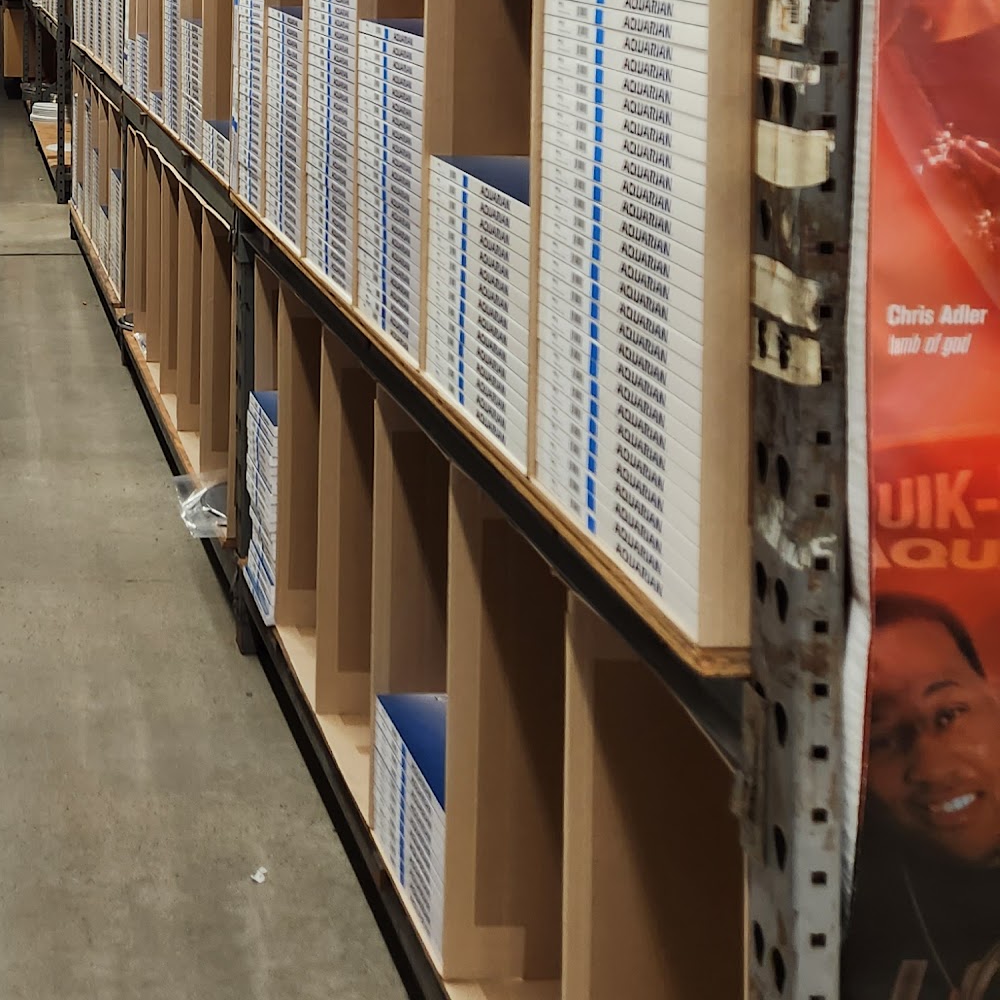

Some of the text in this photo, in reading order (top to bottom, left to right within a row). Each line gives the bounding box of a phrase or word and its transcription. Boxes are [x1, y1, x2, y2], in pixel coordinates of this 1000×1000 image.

[887, 304, 988, 326] Chris Adler
[877, 469, 999, 529] UIK-
